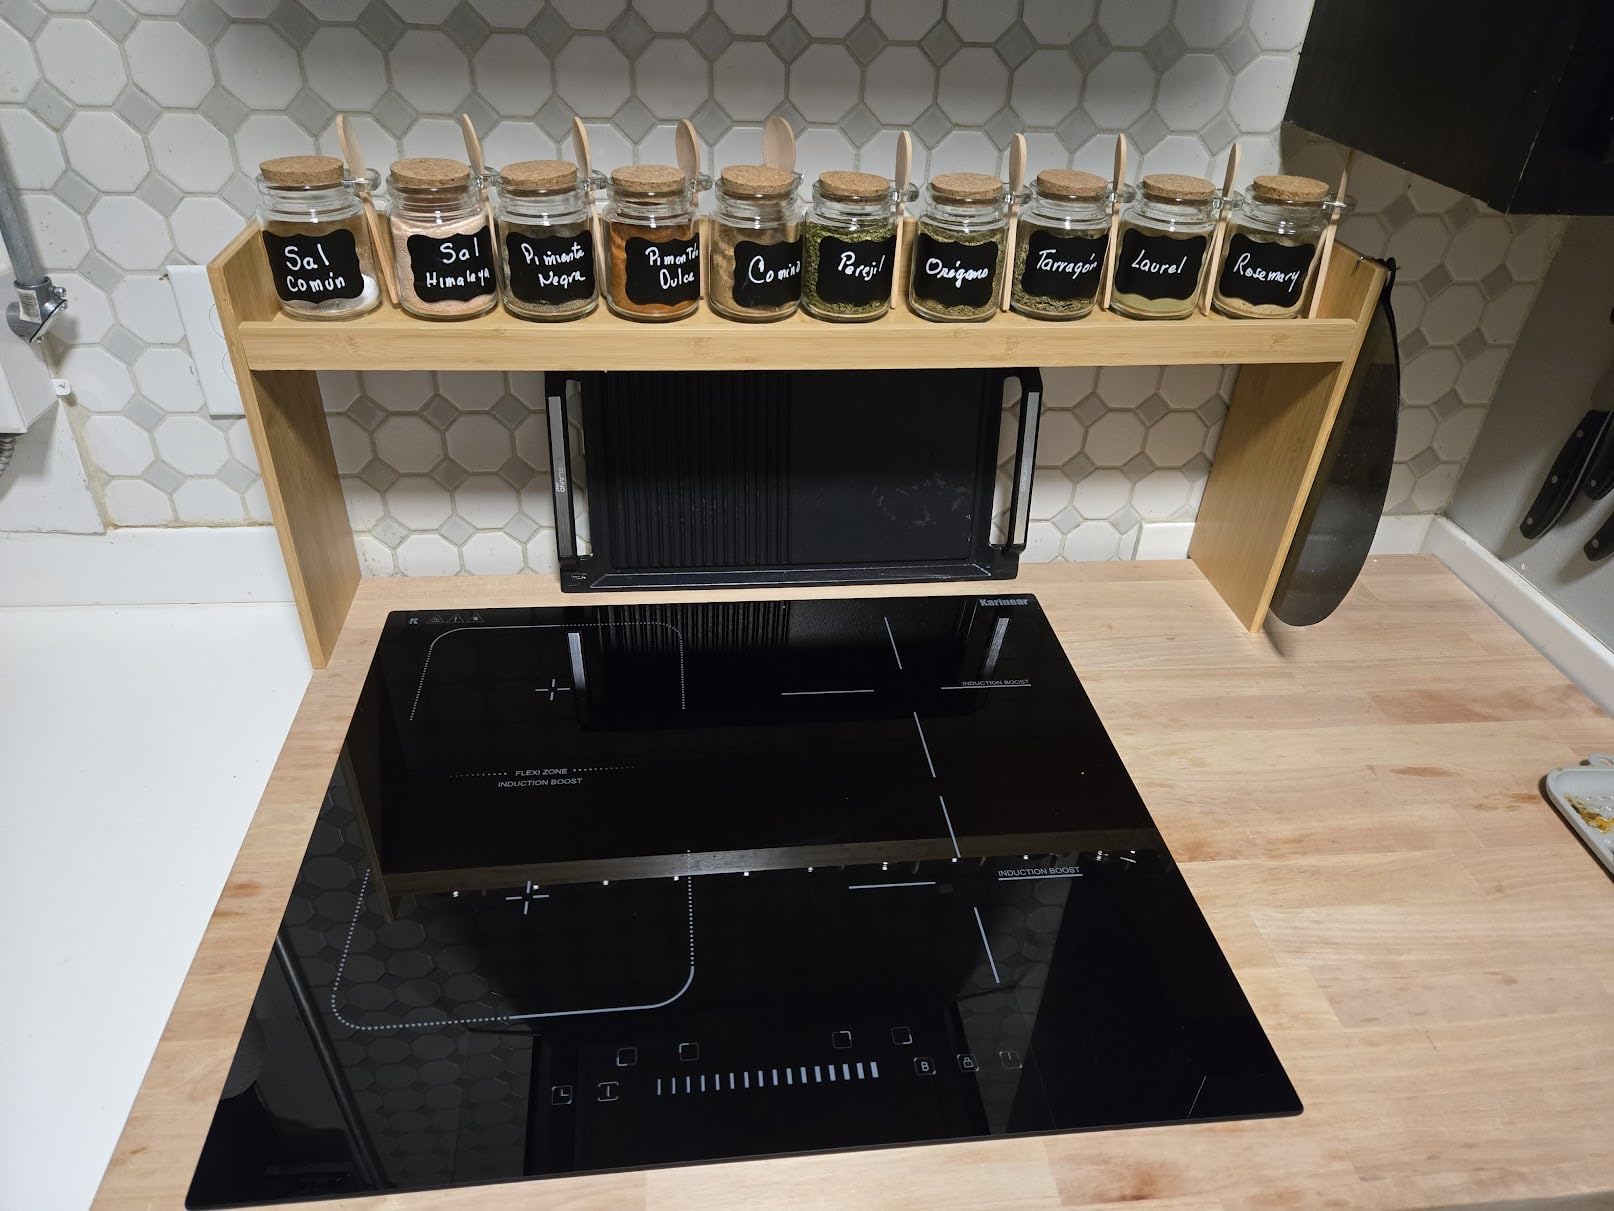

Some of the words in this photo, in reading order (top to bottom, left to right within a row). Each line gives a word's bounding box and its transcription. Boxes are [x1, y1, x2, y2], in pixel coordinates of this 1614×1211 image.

[284, 243, 330, 271] Sal
[439, 236, 479, 264] Sal
[1131, 249, 1188, 275] Laurel
[1233, 252, 1301, 293] Rosemary
[425, 267, 490, 287] Himalaya
[538, 270, 586, 289] Negra
[659, 267, 695, 290] Dulce
[497, 779, 549, 788] INDUCTION
[550, 777, 583, 786] BOOST
[515, 769, 541, 777] FLEXI
[542, 768, 568, 776] ZONE
[997, 867, 1048, 877] INDUCTION
[1049, 866, 1080, 875] BOOST
